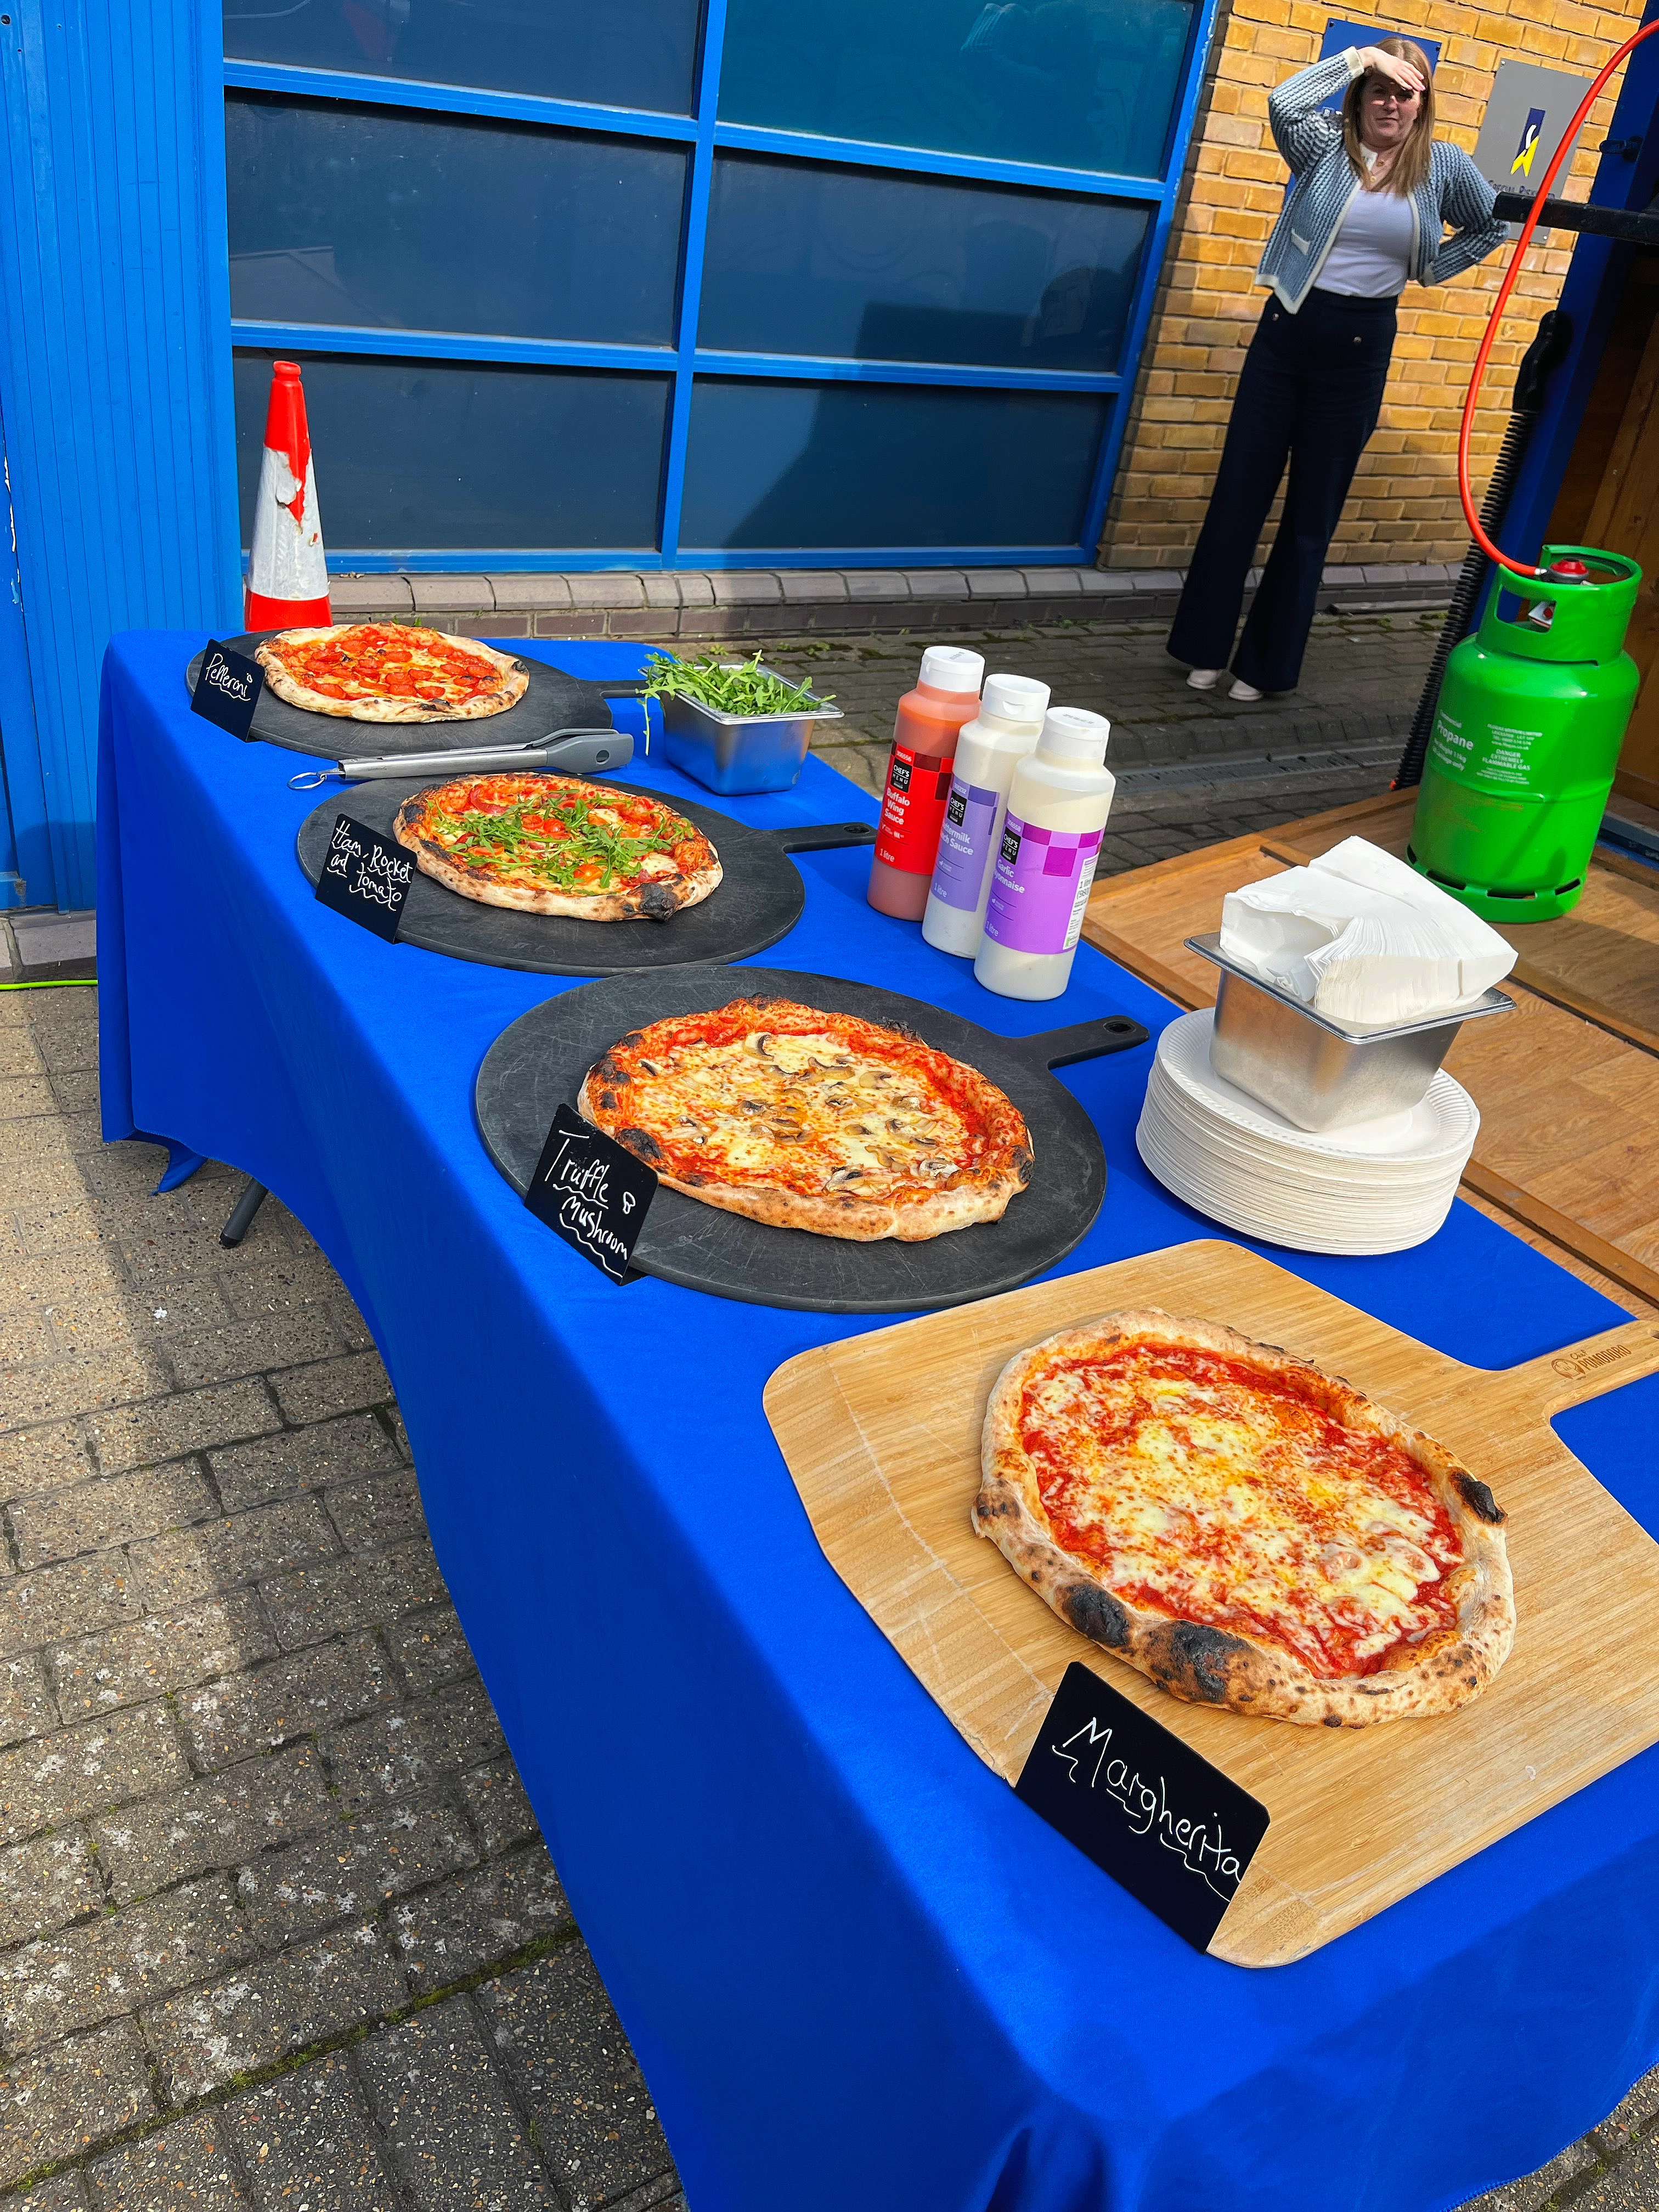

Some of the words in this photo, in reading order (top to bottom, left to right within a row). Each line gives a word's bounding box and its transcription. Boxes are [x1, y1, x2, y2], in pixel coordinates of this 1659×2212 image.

[892, 773, 909, 785] MENU
[894, 764, 910, 777] CHEF'S
[887, 787, 910, 806] Buffalo
[951, 797, 964, 810] CHEF'S
[887, 798, 905, 816] Wing
[884, 808, 904, 825] Sauce
[949, 838, 974, 855] Sauce
[1004, 834, 1019, 848] CHEF'S
[370, 845, 413, 883] Rocket
[883, 850, 895, 862] litre
[998, 859, 1014, 878] Garlic
[937, 884, 947, 898] litre
[989, 923, 998, 936] litre
[545, 1129, 610, 1203] Truffle
[1570, 1349, 1588, 1360] Chef
[1578, 1344, 1632, 1370] POMODORO
[1062, 1717, 1242, 1884] Margherita
